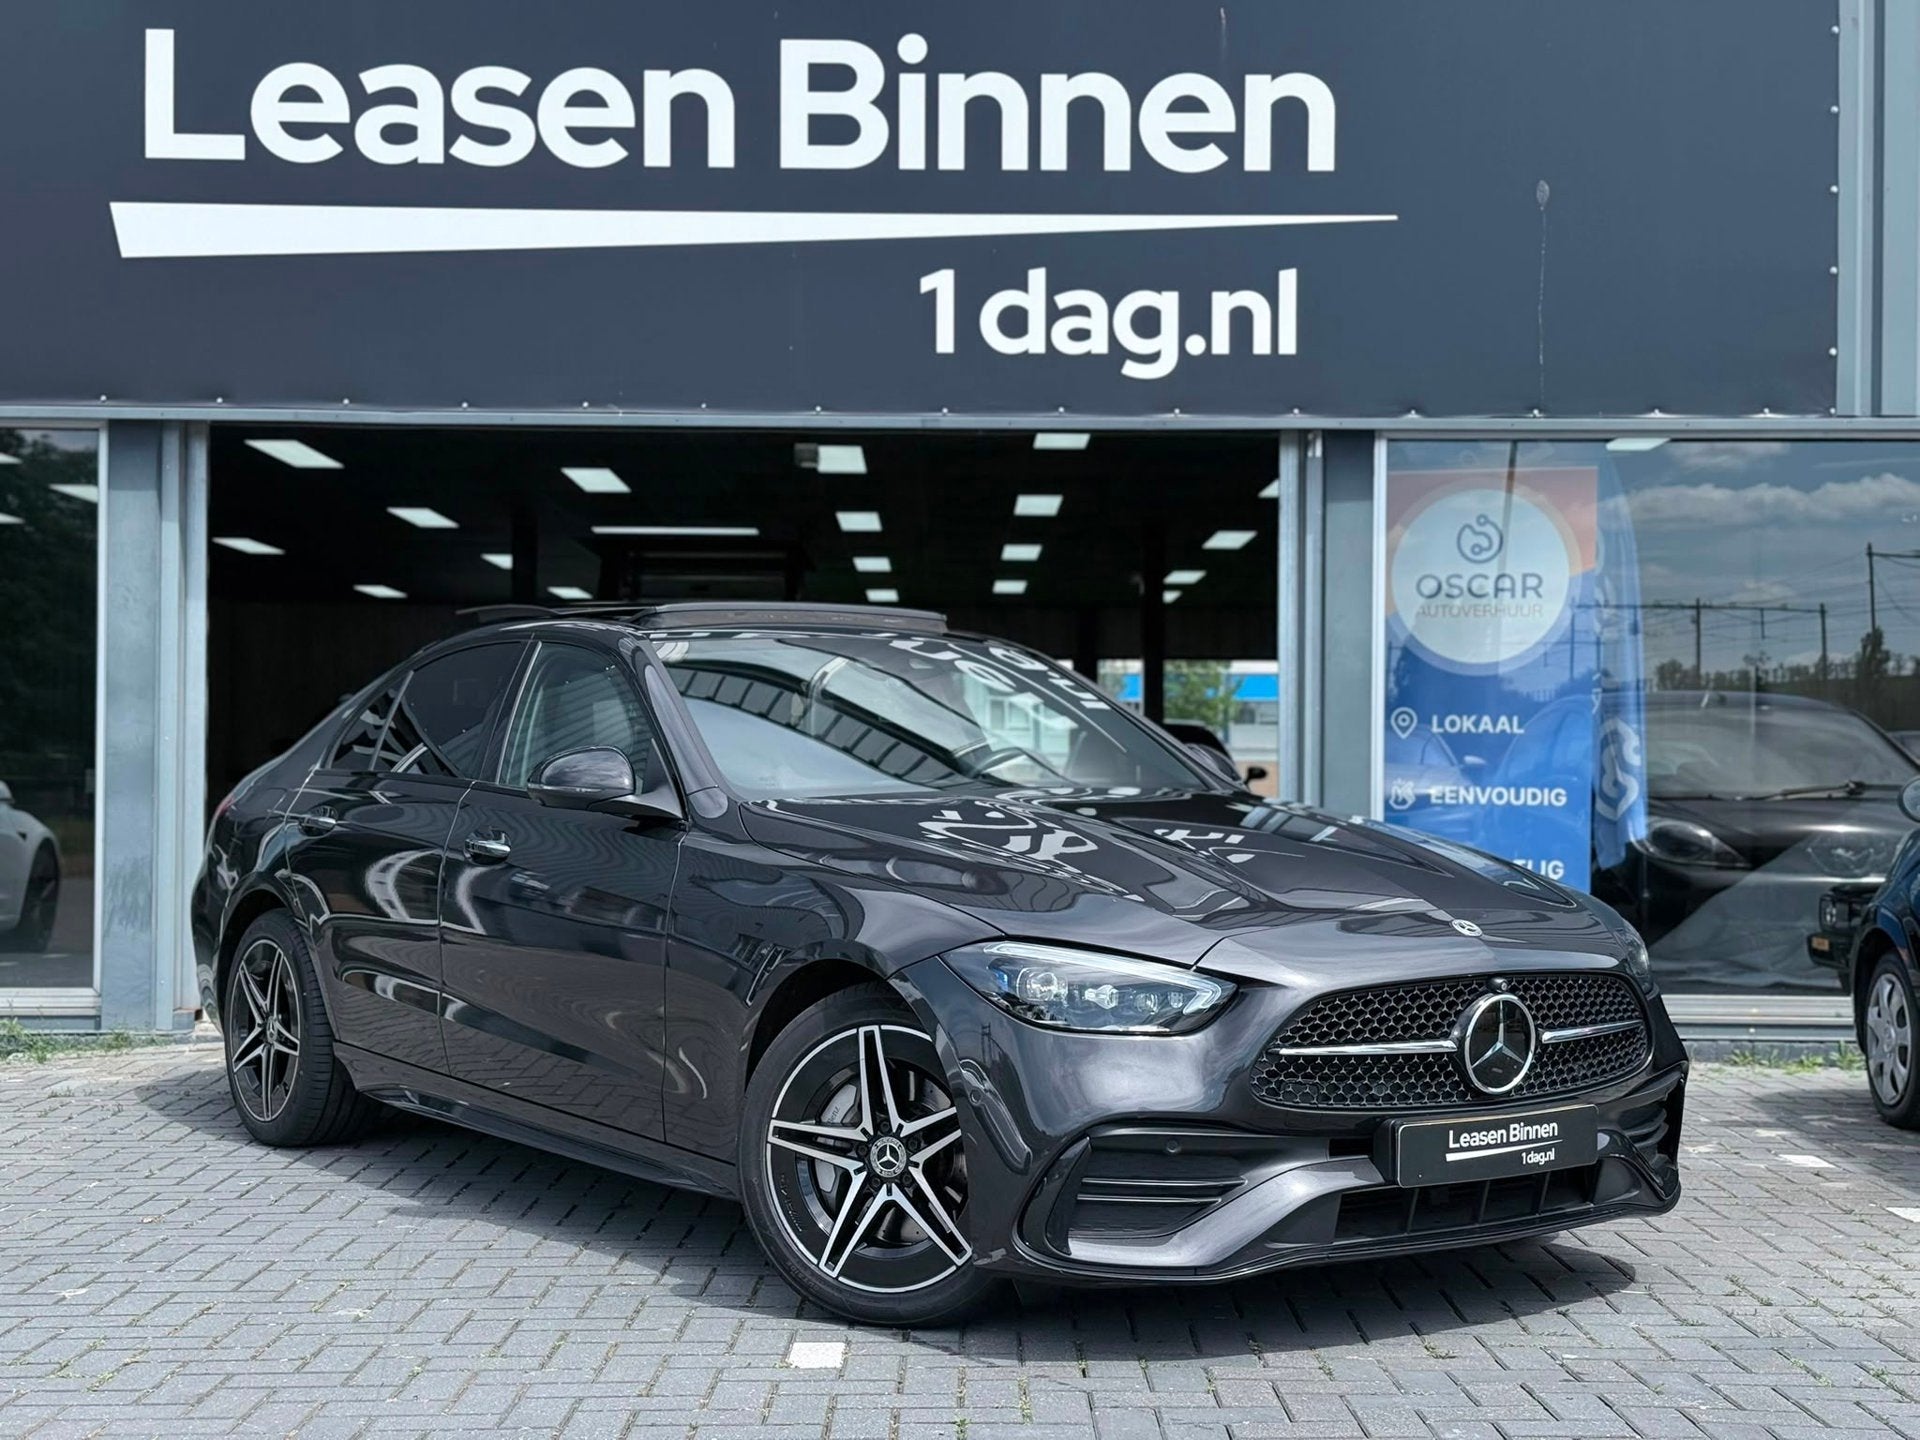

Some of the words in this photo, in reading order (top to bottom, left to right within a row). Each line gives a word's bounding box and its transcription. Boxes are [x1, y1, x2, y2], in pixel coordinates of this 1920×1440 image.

[144, 27, 736, 169] Leasen
[779, 32, 1336, 174] Binnen
[1415, 572, 1544, 600] OSCAR
[1418, 602, 1544, 619] AUTOVERHUUR
[1430, 714, 1525, 735] LOKAAL
[1430, 785, 1568, 807] EENVOUDIG
[1448, 1129, 1507, 1149] Leasen
[1509, 1121, 1558, 1142] Binnen
